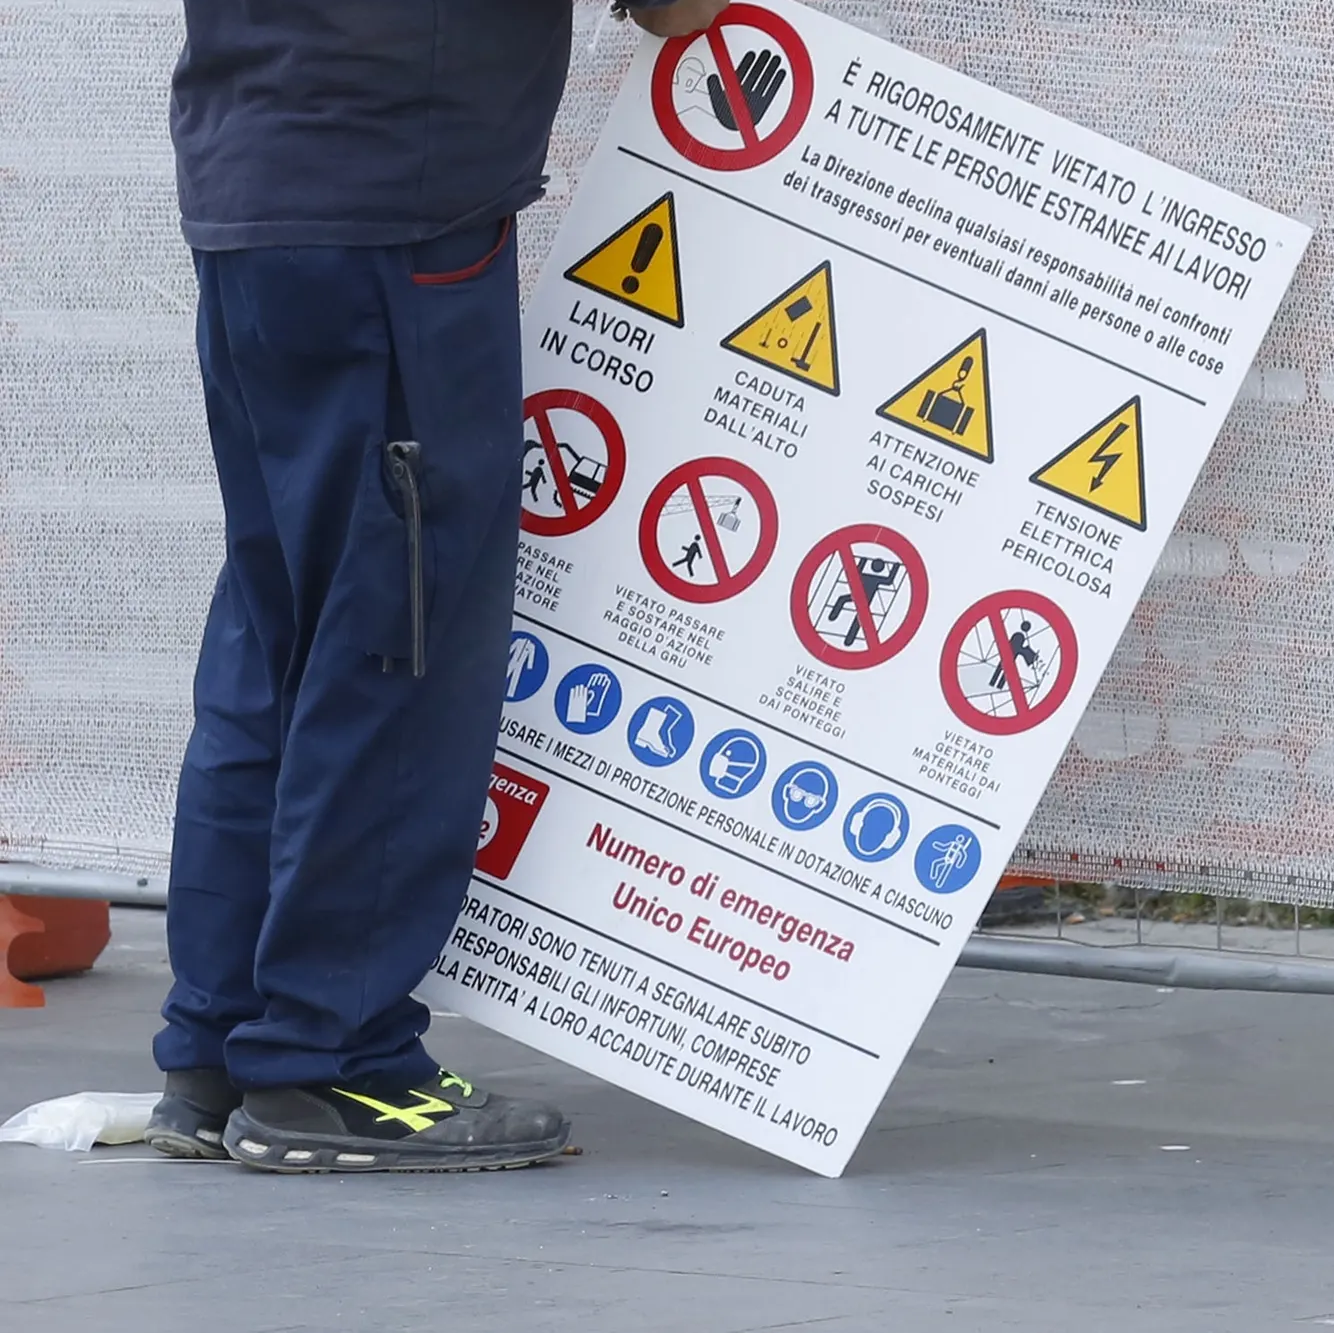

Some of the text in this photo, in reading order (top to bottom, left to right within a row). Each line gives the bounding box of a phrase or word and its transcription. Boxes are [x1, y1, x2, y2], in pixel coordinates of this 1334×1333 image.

[865, 70, 1045, 166] RIGOROSAMENTE
[1051, 149, 1136, 205] VIETATO
[1140, 190, 1267, 262] L'INGRESSO
[823, 97, 1252, 301] A TUTTE LE PERSONE ESTRANEE AI LAVORI
[782, 169, 1224, 375] dei trasgressori per eventuali danni alle persone o alle cose
[800, 144, 1233, 346] La Direzione declina qualsiasi responsabilità nei confronti
[568, 299, 655, 355] LAVORI
[539, 326, 654, 393] IN CORSO
[712, 385, 808, 438] MATERIALI
[734, 369, 805, 413] CADUTA
[703, 406, 798, 459] DALL'ALTO
[868, 430, 980, 488] ATTENZIONE
[865, 454, 963, 506] AI CARICHI
[866, 478, 944, 523] SOSPESI
[1019, 519, 1113, 574] ELETTRICA
[1035, 499, 1123, 551] TENSIONE
[535, 564, 558, 583] NEL
[1000, 537, 1112, 599] PERICOLOSA
[602, 609, 713, 666] RAGGIO D'AZIONE
[615, 583, 725, 641] VIETATO PASSARE
[615, 600, 710, 650] E SOSTARE NEL
[617, 630, 688, 669] DELLA GRU
[774, 685, 842, 722] SCENDERE
[786, 675, 842, 708] SALIRE E
[795, 664, 846, 694] VIETATO
[758, 693, 846, 739] DAI PONTEGGI
[911, 746, 1001, 793] MATERIALI DAI
[934, 741, 991, 773] GETTARE
[943, 729, 994, 760] VIETATO
[918, 763, 982, 800] PONTEGGI
[544, 737, 554, 753] I
[551, 740, 596, 772] MEZZI
[594, 759, 612, 779] DI
[610, 766, 698, 817] PROTEZIONE
[695, 804, 780, 853] PERSONALE
[777, 840, 796, 861] IN
[793, 848, 872, 894] DOTAZIONE
[869, 883, 883, 900] A
[883, 888, 953, 930] CIASCUNO
[585, 821, 855, 962] Numero di emergenza
[612, 881, 791, 981] Unico Europeo
[450, 925, 782, 1087] RESPONSABILI GLI INFORTUNI, COMPRESE
[527, 925, 577, 962] SONO
[578, 947, 638, 989] TENUTI
[634, 975, 650, 996] A
[651, 981, 752, 1039] SEGNALARE
[749, 1025, 811, 1066] SUBITO
[432, 954, 838, 1147] LA ENTITA' A LORO ACCADUTE DURANTE IL LAVORO
